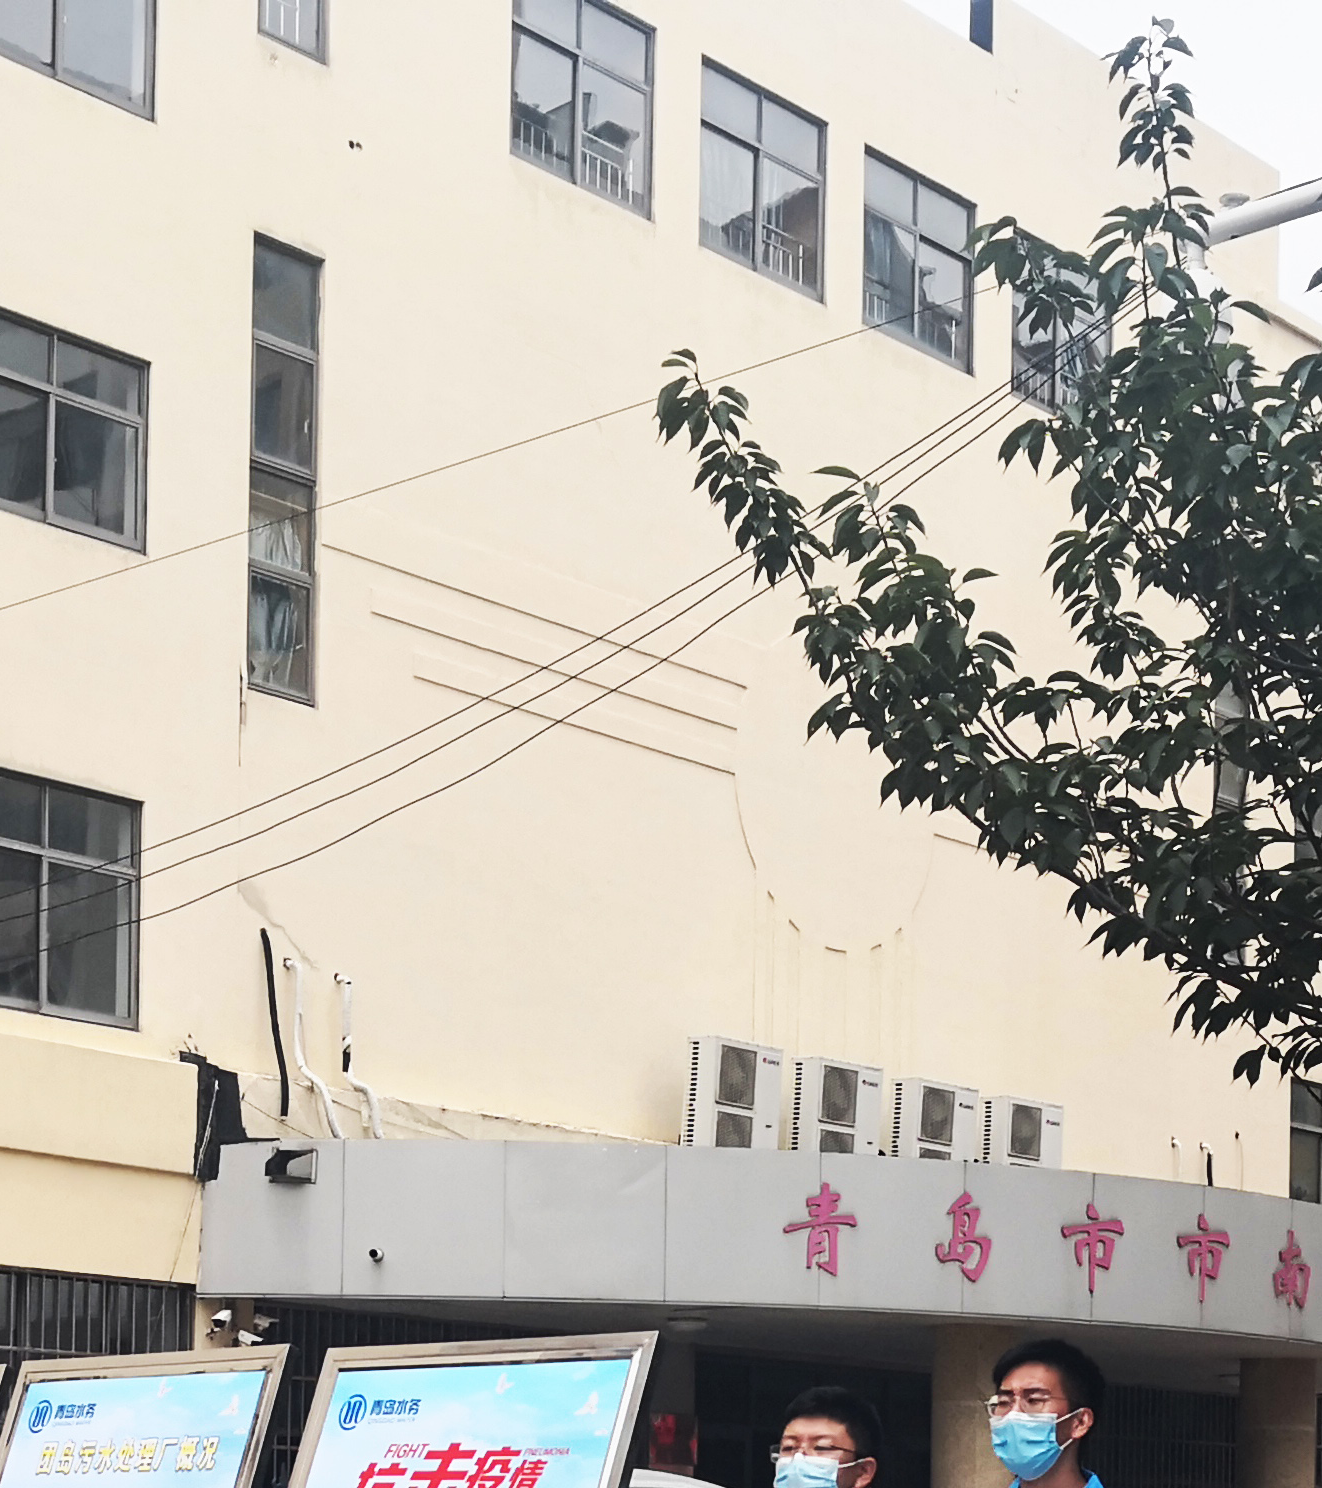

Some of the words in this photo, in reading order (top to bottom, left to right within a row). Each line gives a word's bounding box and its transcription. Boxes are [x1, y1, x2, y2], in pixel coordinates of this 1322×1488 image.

[369, 1399, 422, 1416] 青岛水务
[35, 1436, 220, 1477] 团岛污水处理厂概况
[384, 1443, 429, 1459] FIGHT
